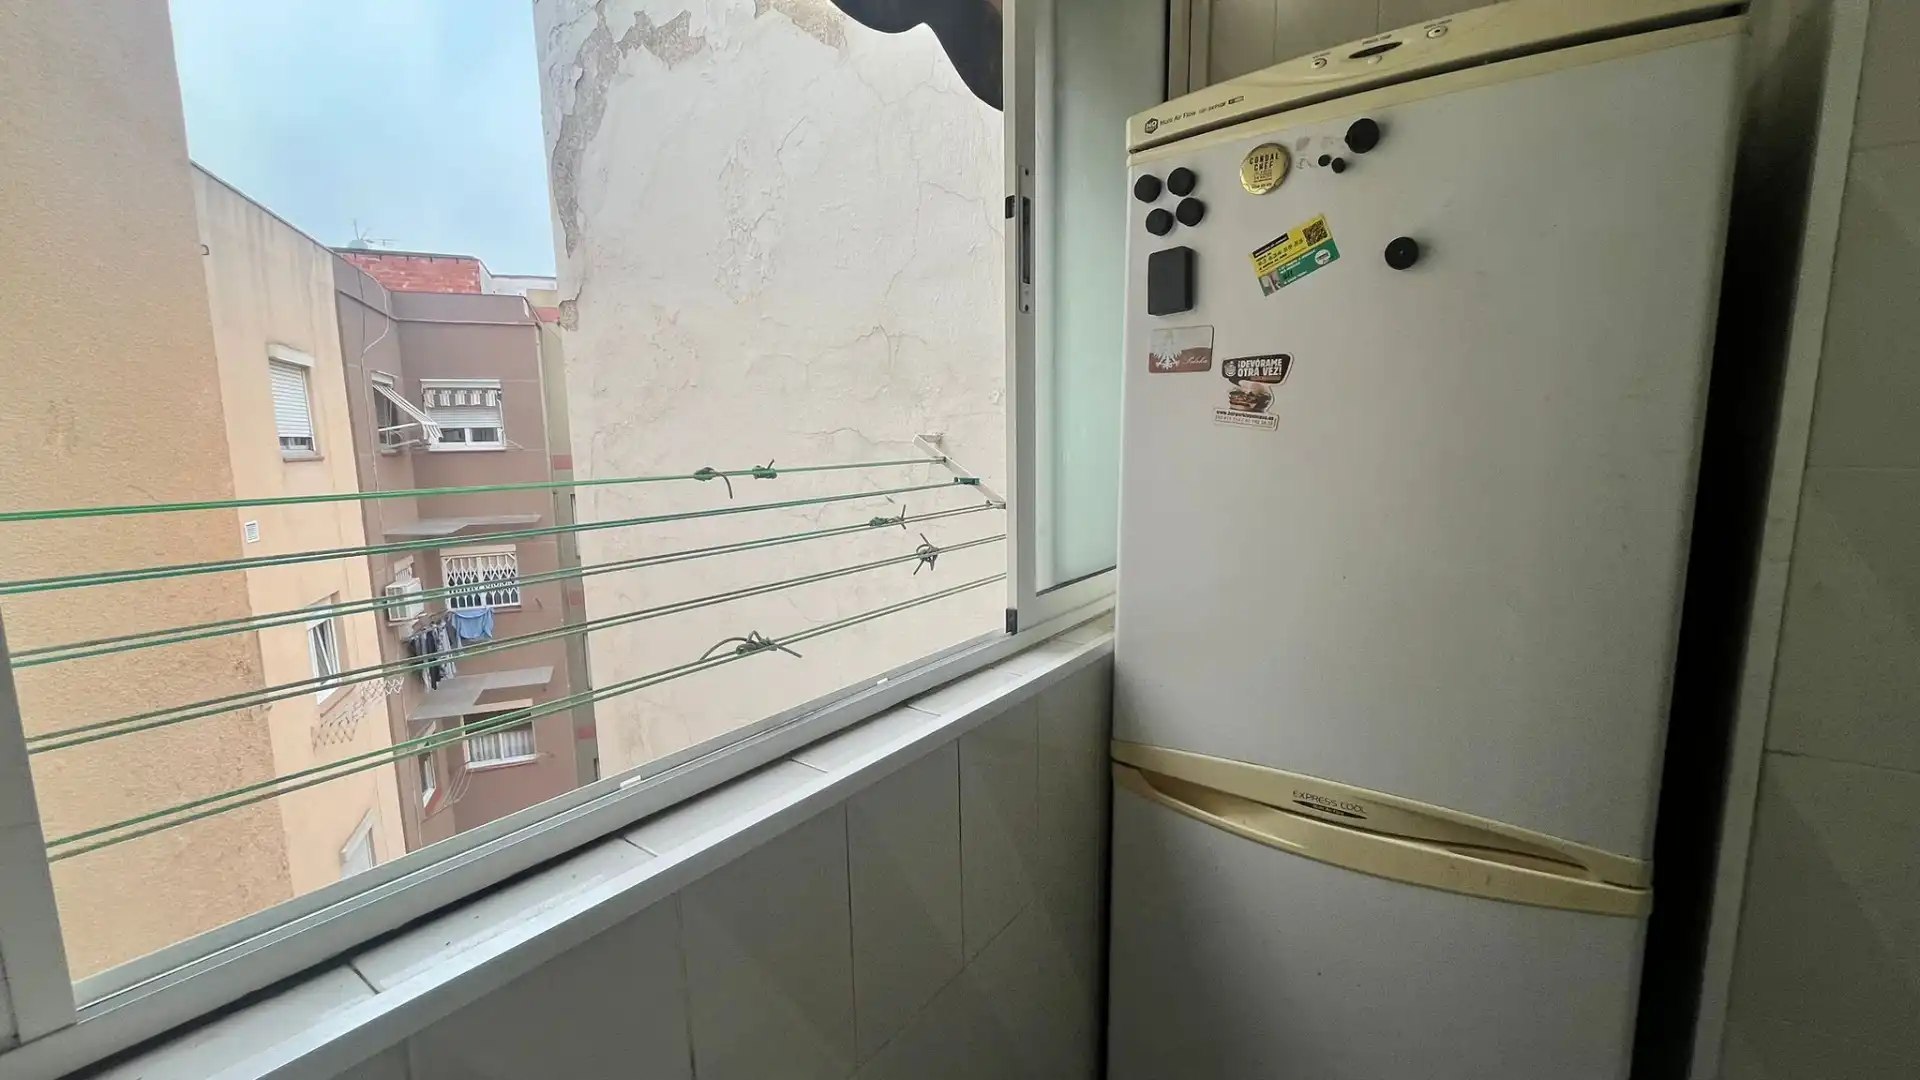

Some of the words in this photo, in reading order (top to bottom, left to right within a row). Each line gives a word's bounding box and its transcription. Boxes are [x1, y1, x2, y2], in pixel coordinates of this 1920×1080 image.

[1253, 160, 1274, 171] CHEF
[1237, 358, 1283, 369] ¡DEVÓRAME
[1237, 368, 1260, 377] OTRA
[1262, 366, 1282, 376] VEZ!
[1292, 789, 1338, 807] EXPRESS
[1340, 801, 1367, 814] COOL
